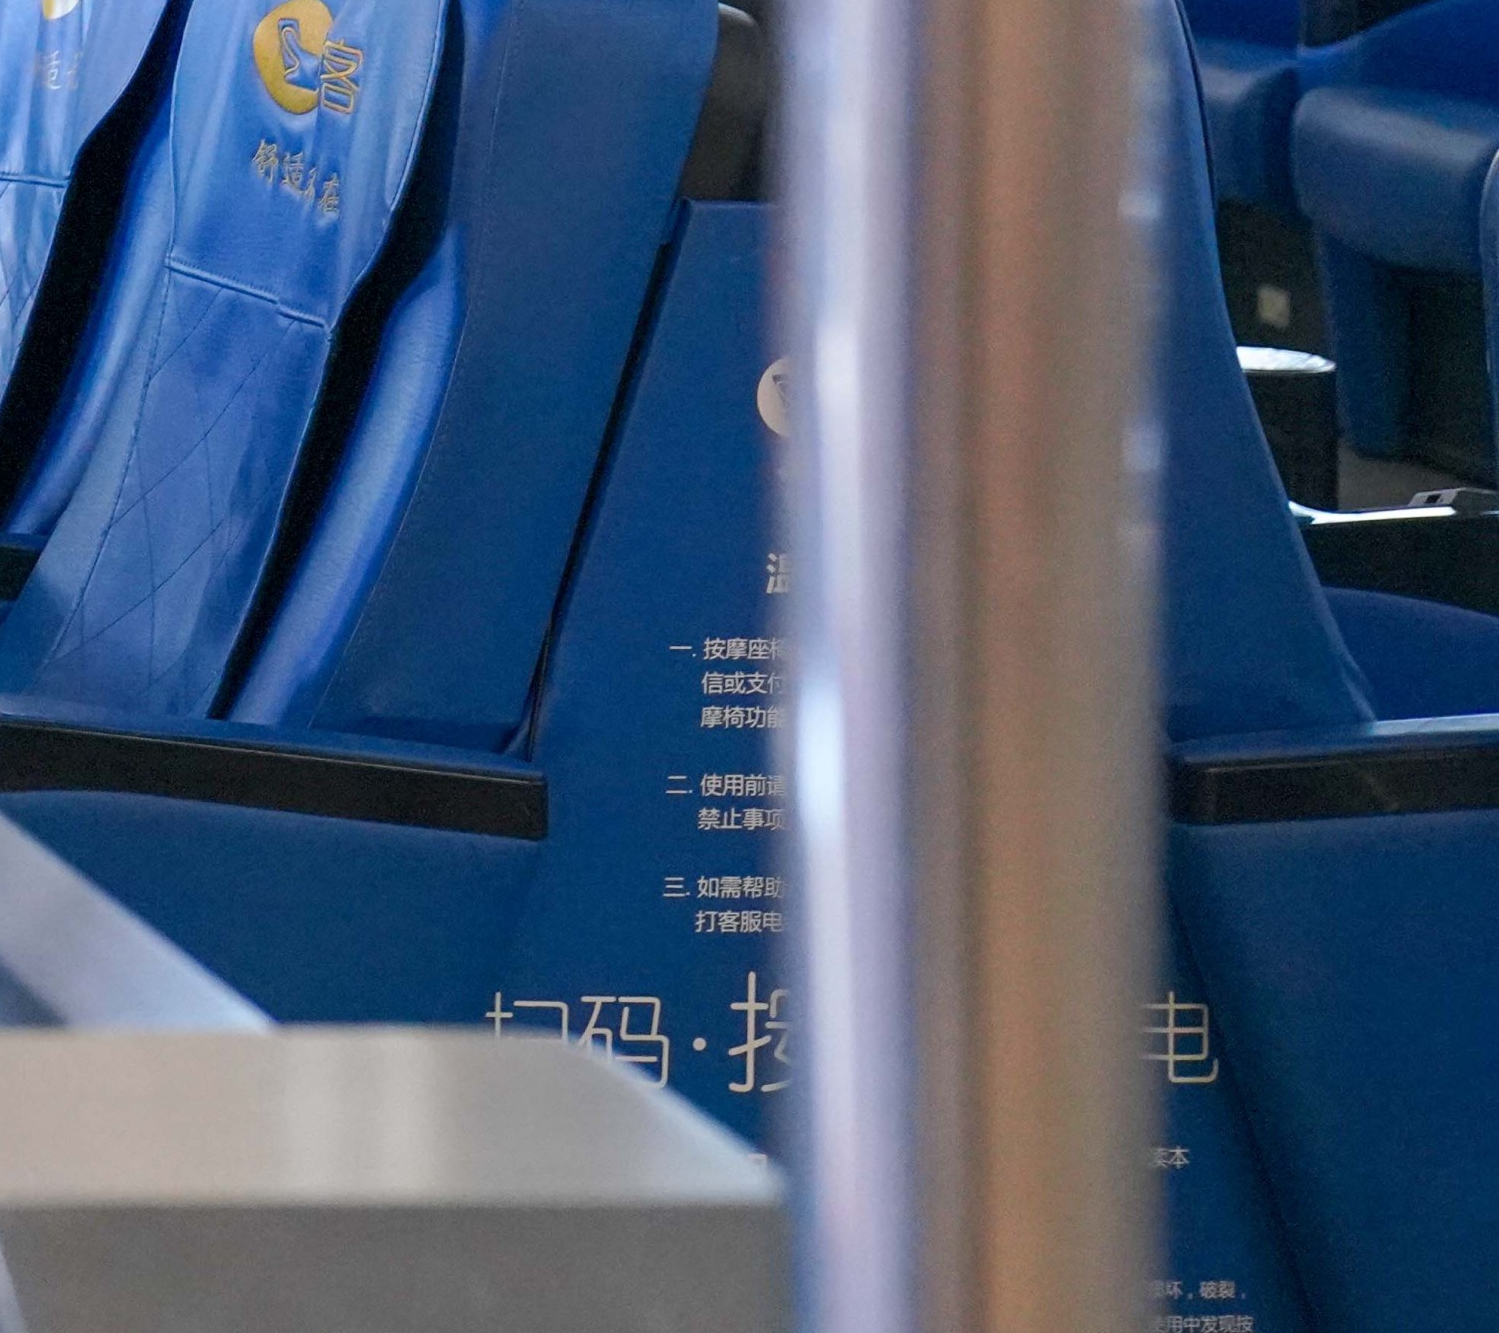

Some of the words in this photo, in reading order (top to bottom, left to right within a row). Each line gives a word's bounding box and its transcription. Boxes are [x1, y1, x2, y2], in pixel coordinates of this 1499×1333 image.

[697, 808, 786, 831] 禁止事项
[1137, 990, 1219, 1083] 电
